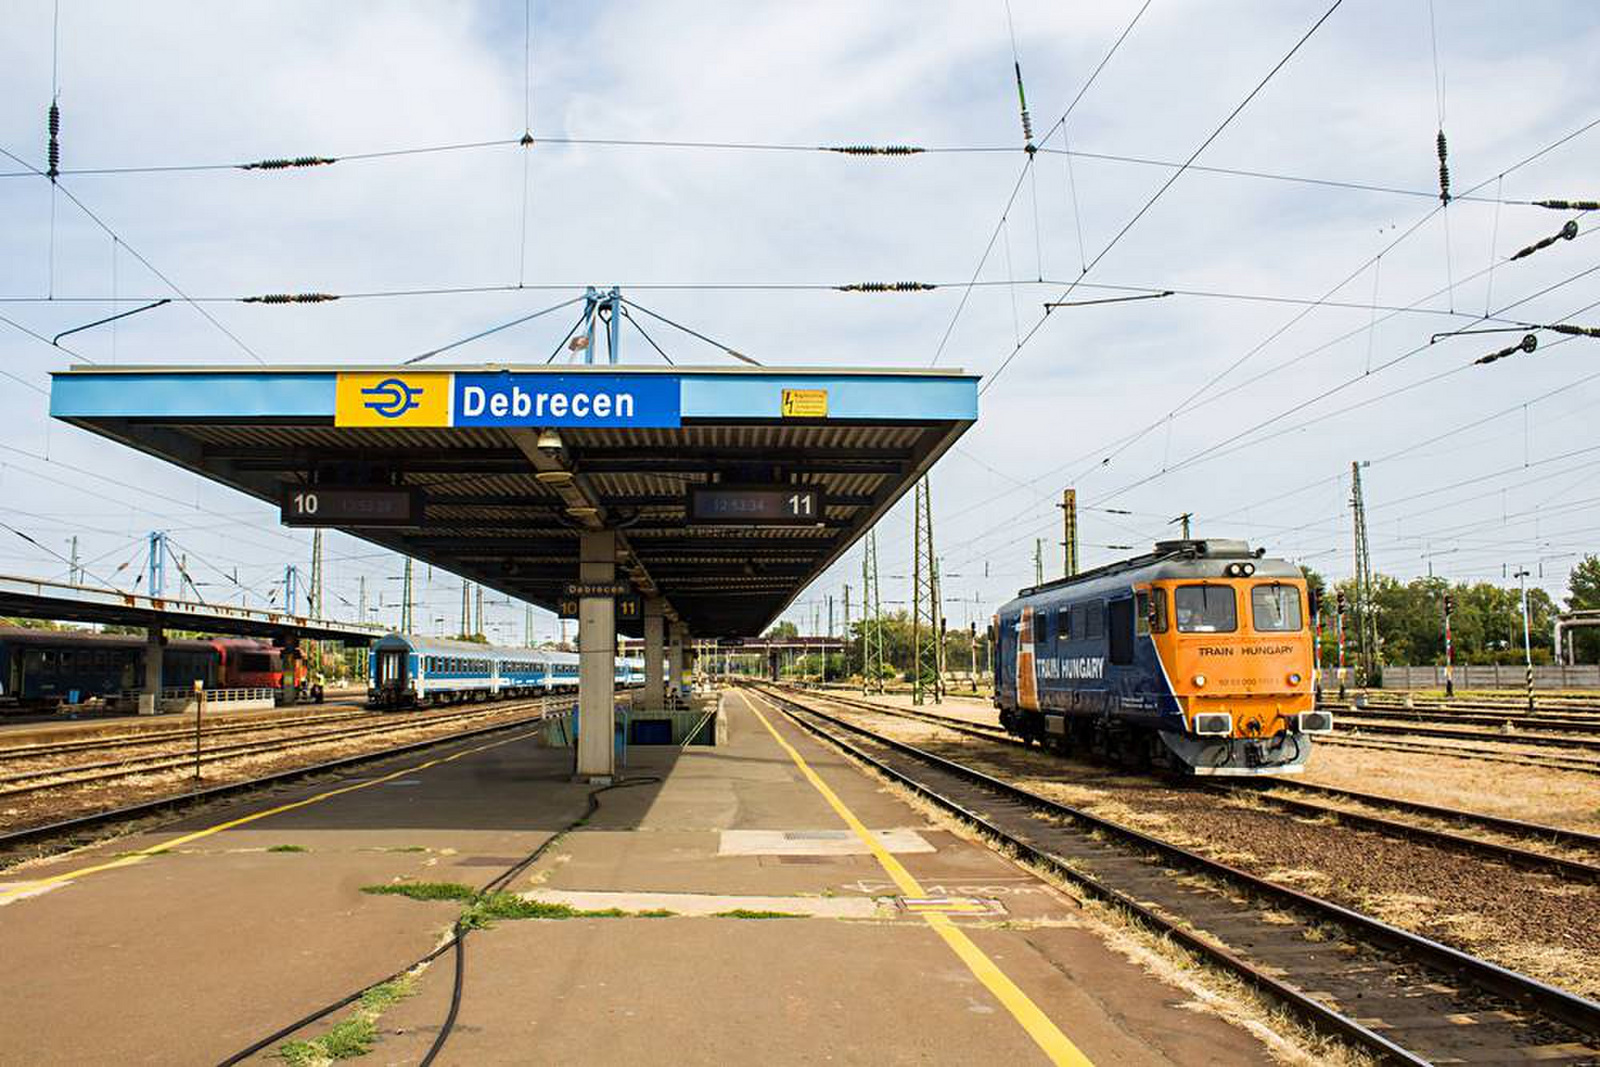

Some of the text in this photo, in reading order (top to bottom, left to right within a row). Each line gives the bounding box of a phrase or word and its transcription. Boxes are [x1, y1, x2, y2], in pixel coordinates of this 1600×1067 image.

[463, 386, 634, 418] Debrecen
[293, 494, 318, 514] 10
[788, 494, 812, 515] 11
[568, 585, 625, 594] Debrecen
[562, 602, 577, 615] 10
[622, 601, 635, 615] 11
[1199, 645, 1294, 657] TRAIN HUNGARY
[1036, 656, 1105, 679] TRAIN HUNGARY
